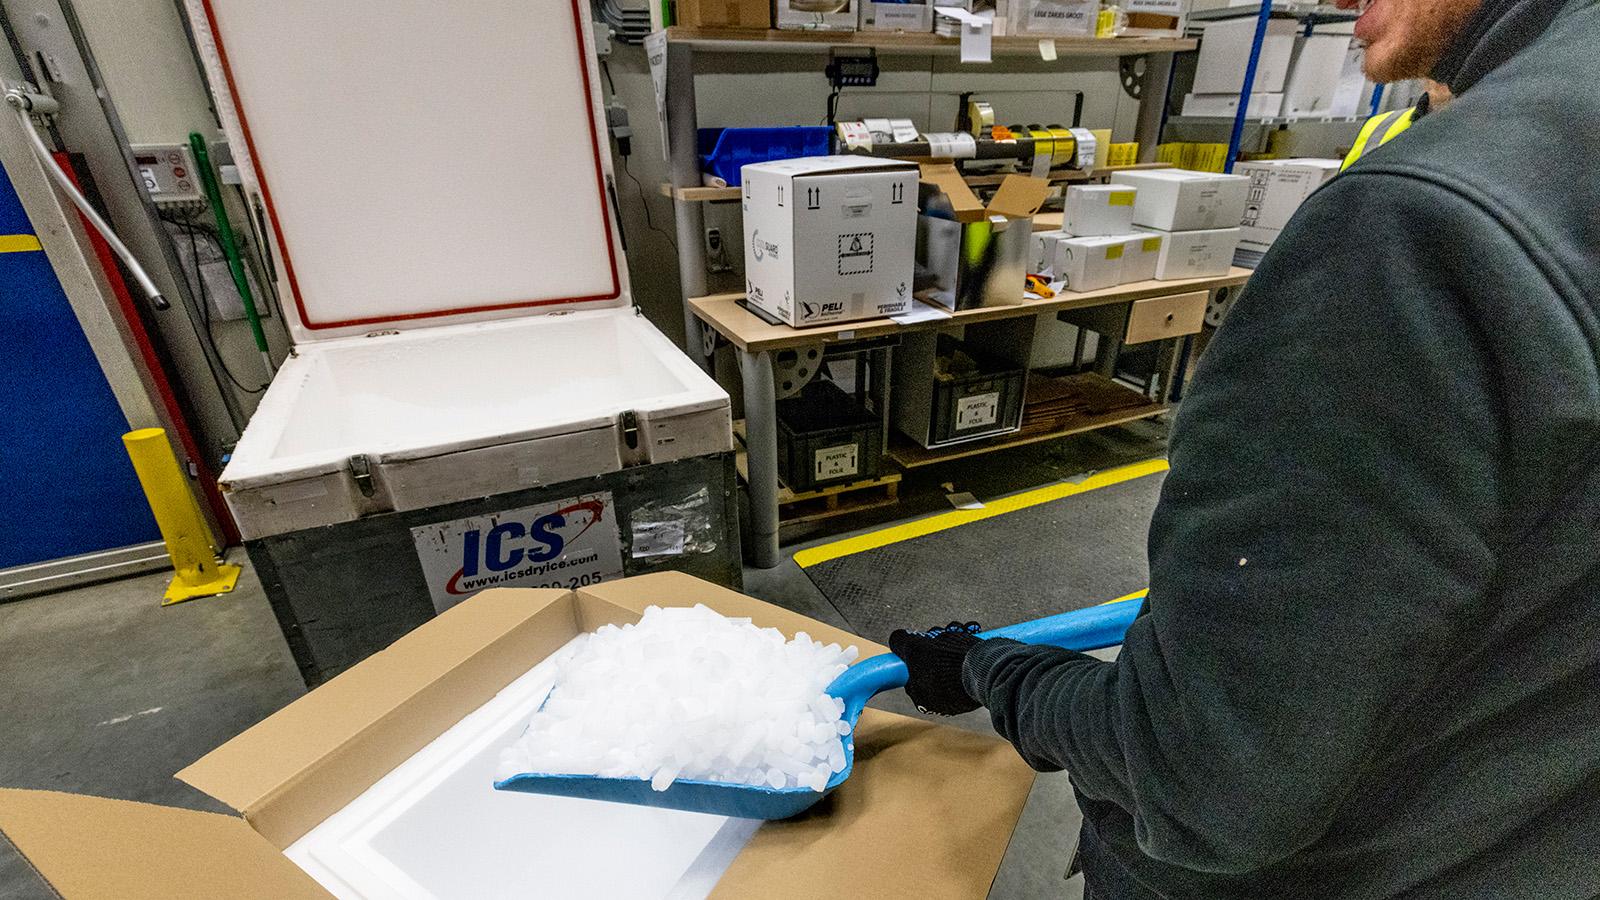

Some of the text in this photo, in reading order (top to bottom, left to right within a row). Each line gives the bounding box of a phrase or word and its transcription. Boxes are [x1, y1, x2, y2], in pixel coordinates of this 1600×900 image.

[1034, 10, 1047, 18] LEGE
[821, 302, 843, 312] PELI
[966, 401, 988, 410] PLASTIC
[825, 452, 847, 461] PLASTIC
[829, 467, 844, 475] FOLIE
[463, 514, 566, 578] ICS
[463, 553, 599, 590] www.icsdryice.com
